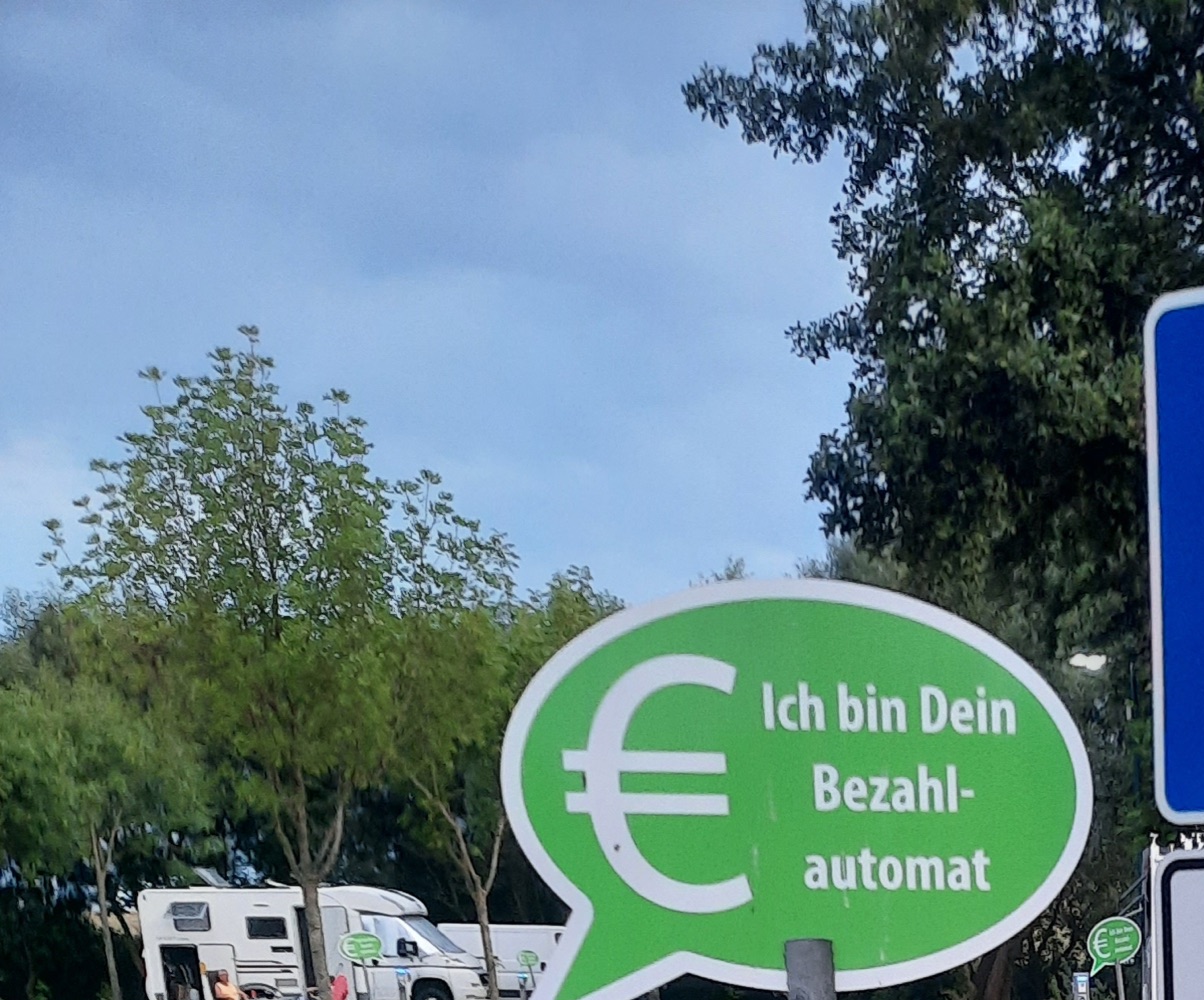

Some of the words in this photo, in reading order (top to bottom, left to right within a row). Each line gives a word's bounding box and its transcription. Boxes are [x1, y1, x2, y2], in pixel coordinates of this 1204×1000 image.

[762, 682, 826, 732] Ich
[838, 682, 907, 733] bin
[921, 685, 1017, 735] Dein
[561, 653, 754, 914] €
[813, 763, 975, 813] Bezahl-
[804, 848, 991, 892] automat
